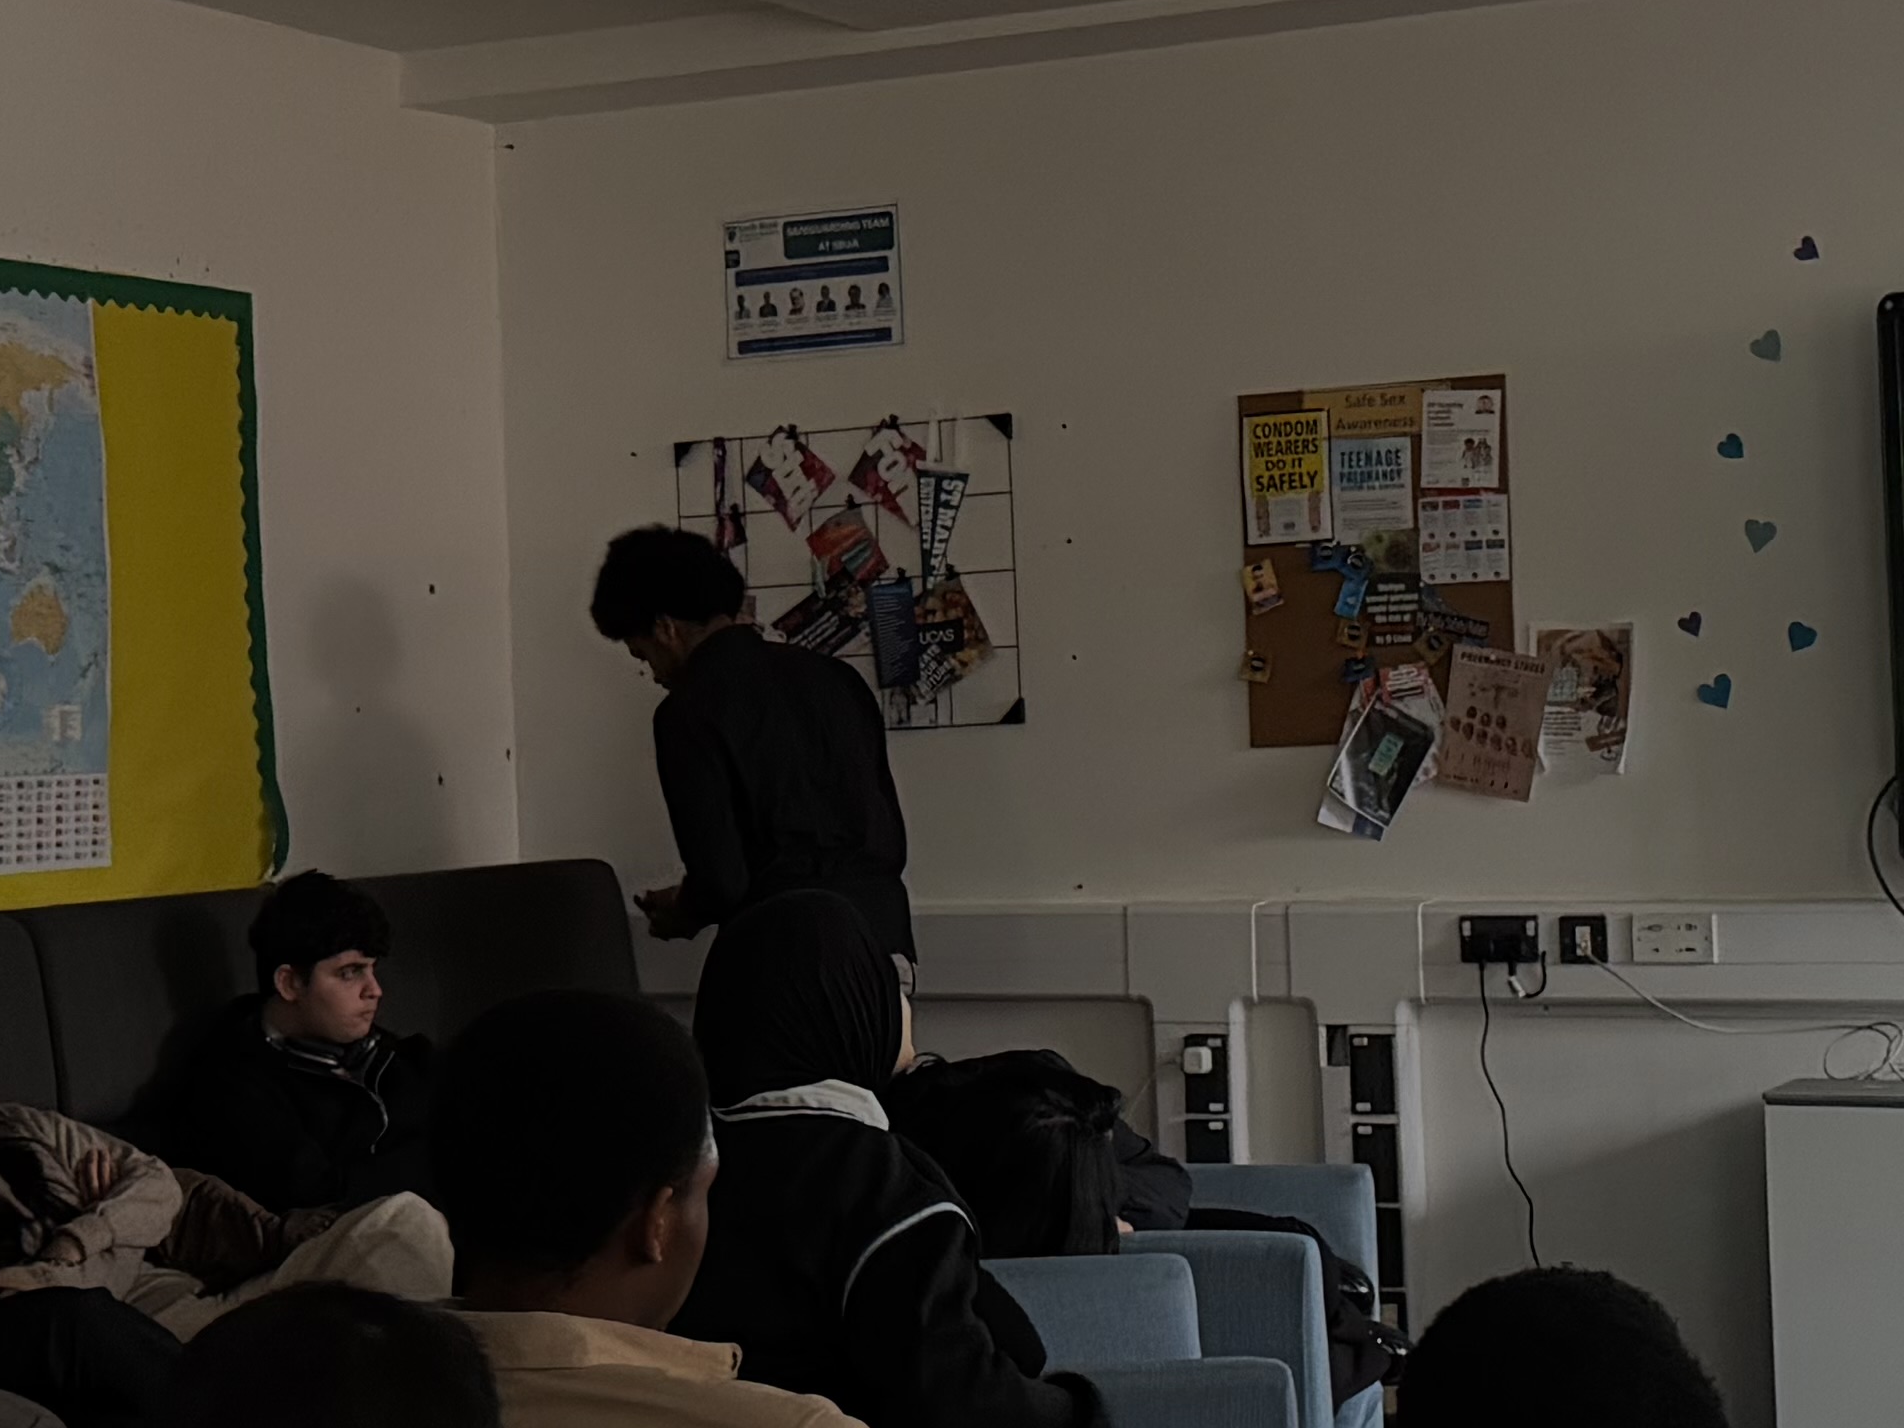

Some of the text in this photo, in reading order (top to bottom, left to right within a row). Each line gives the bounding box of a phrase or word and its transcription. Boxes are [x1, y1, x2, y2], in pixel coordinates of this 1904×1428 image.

[861, 217, 890, 231] TEAM
[1345, 392, 1405, 408] Safe Sex
[1253, 419, 1318, 440] CONDOM
[1336, 417, 1414, 430] Awareness
[1253, 438, 1318, 459] WEARERS
[1265, 458, 1303, 472] DO IT
[1340, 448, 1402, 469] TEENAGE
[1255, 470, 1318, 493] SAFELY
[940, 479, 965, 506] ST
[918, 628, 955, 645] UCAS
